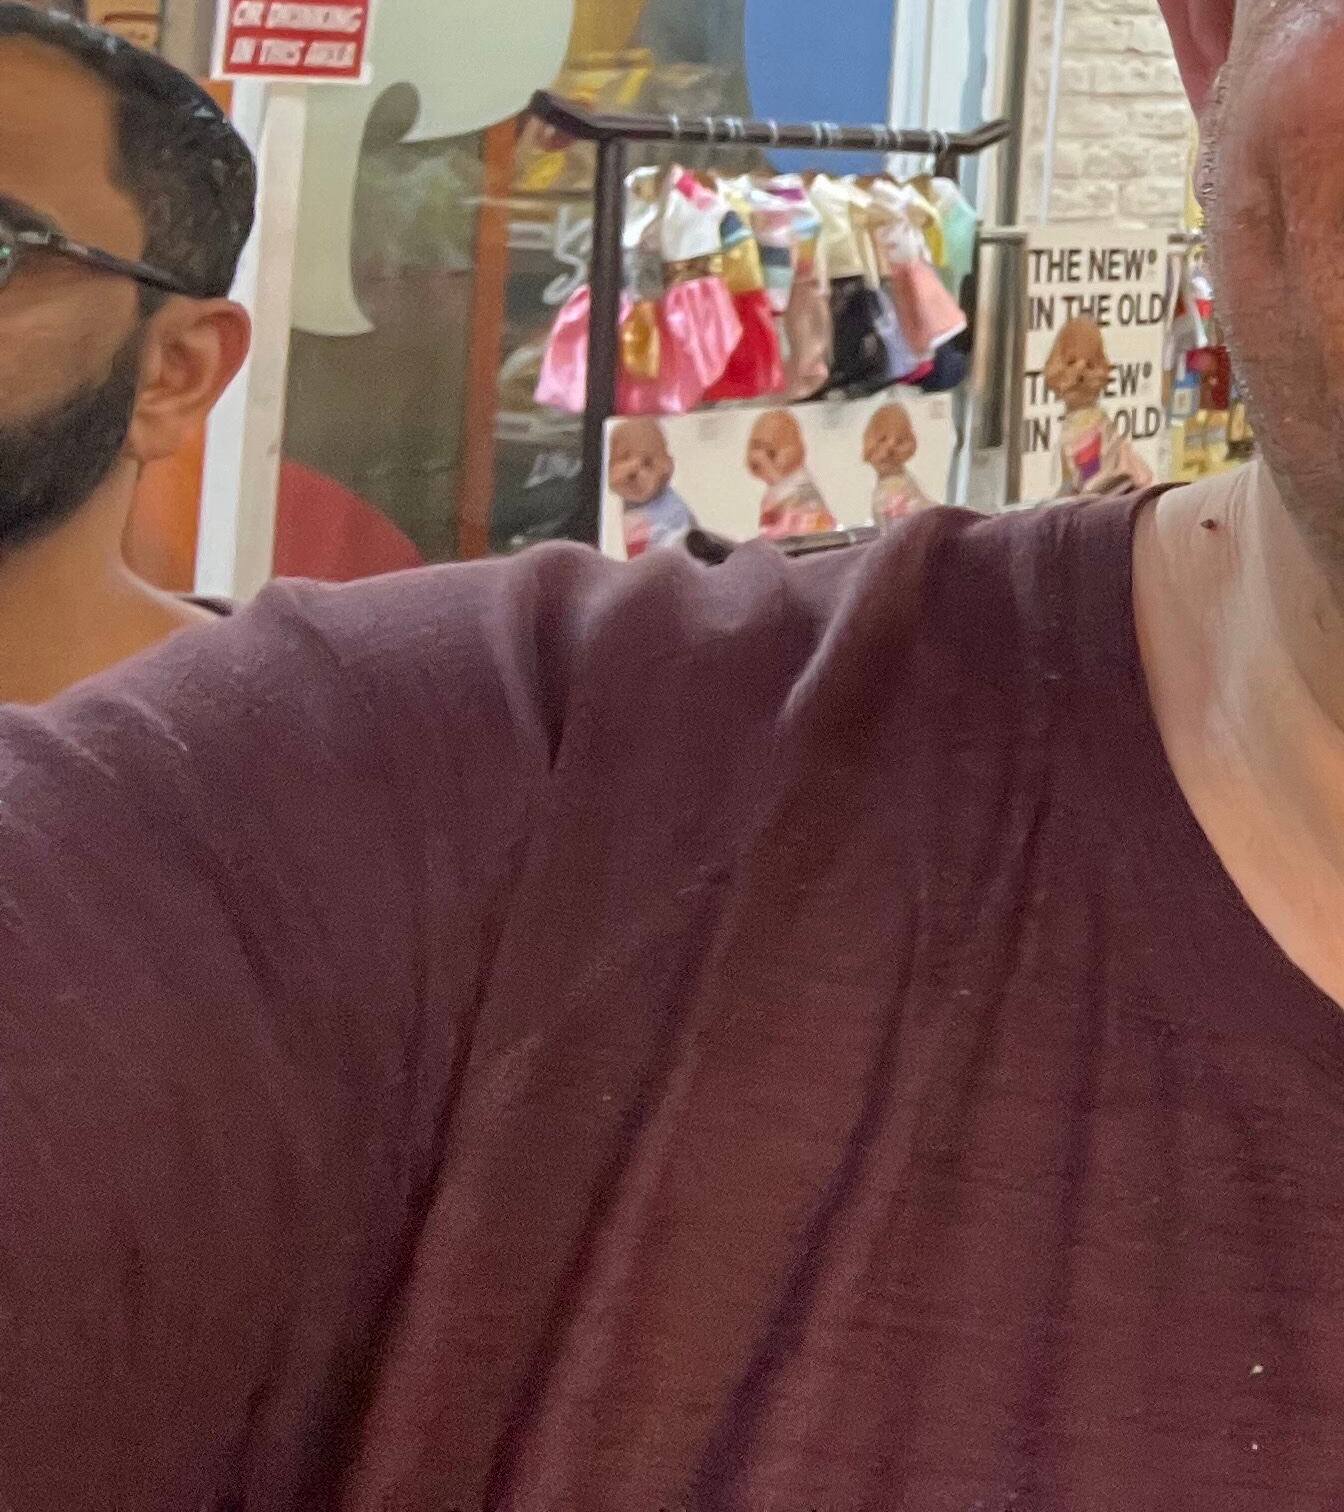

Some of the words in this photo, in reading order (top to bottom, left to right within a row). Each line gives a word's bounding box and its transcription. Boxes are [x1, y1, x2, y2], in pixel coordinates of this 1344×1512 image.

[1029, 249, 1083, 283] THE
[1030, 296, 1054, 331] IN
[1117, 293, 1167, 326] OLD
[1027, 416, 1051, 452] IN
